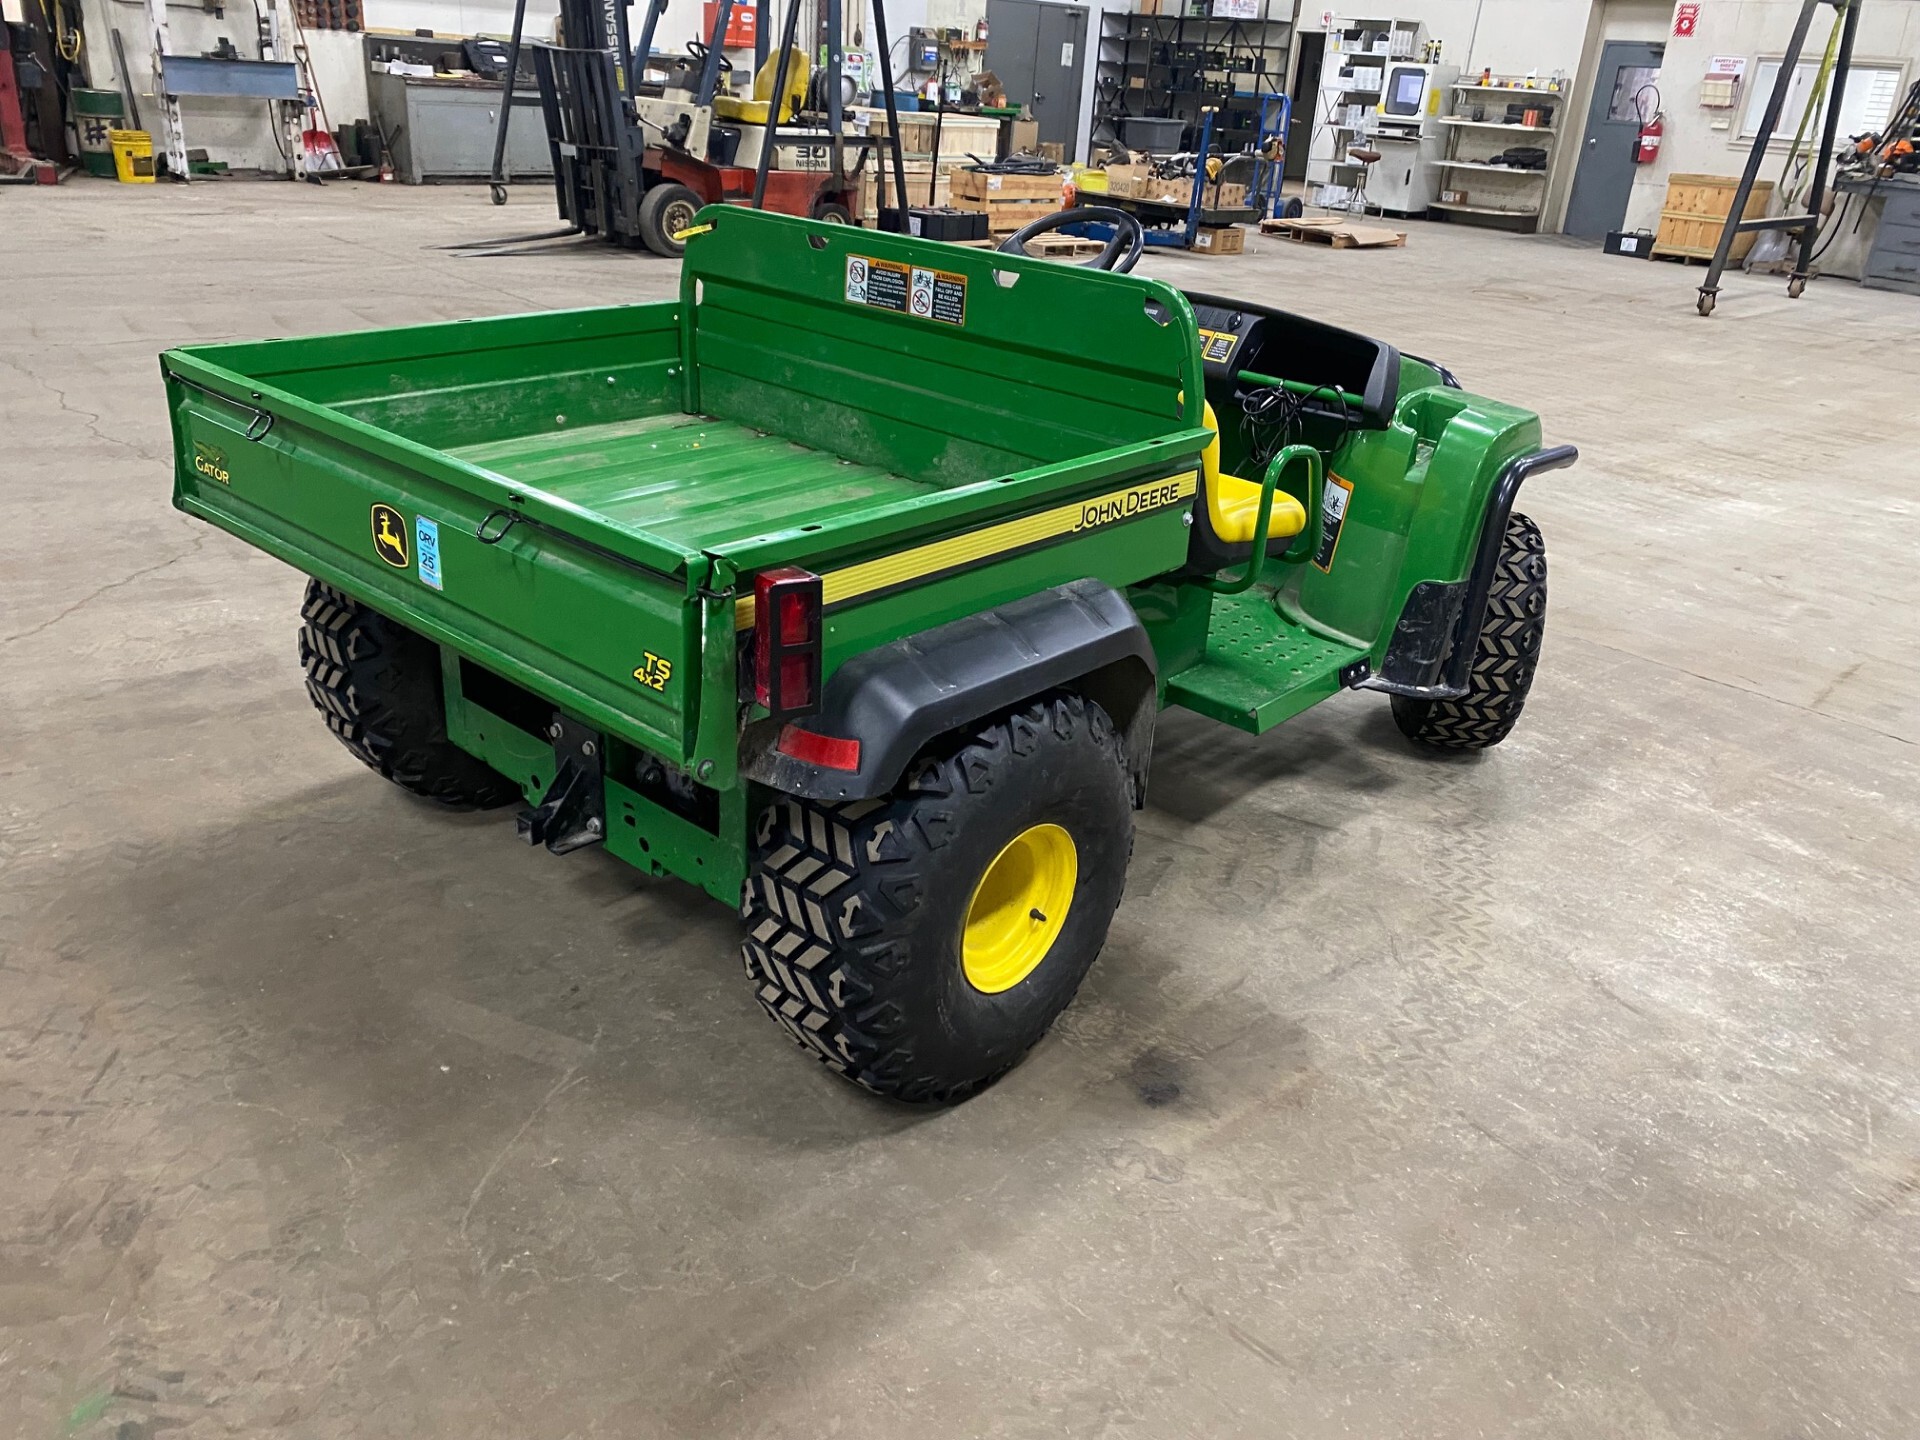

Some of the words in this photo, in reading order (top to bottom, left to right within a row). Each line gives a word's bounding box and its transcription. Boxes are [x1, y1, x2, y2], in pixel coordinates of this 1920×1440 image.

[604, 0, 621, 66] NISSAN
[796, 160, 827, 168] NISSAN
[880, 262, 904, 271] WARNING
[871, 274, 883, 282] FROM
[883, 276, 905, 286] EXPLOSION
[940, 274, 966, 284] WARNING
[195, 455, 229, 485] GATOR
[1074, 499, 1123, 529] JOHN
[1126, 482, 1180, 514] DEERE
[421, 552, 435, 570] 25
[643, 651, 672, 681] TS
[633, 667, 665, 691] 4x2
